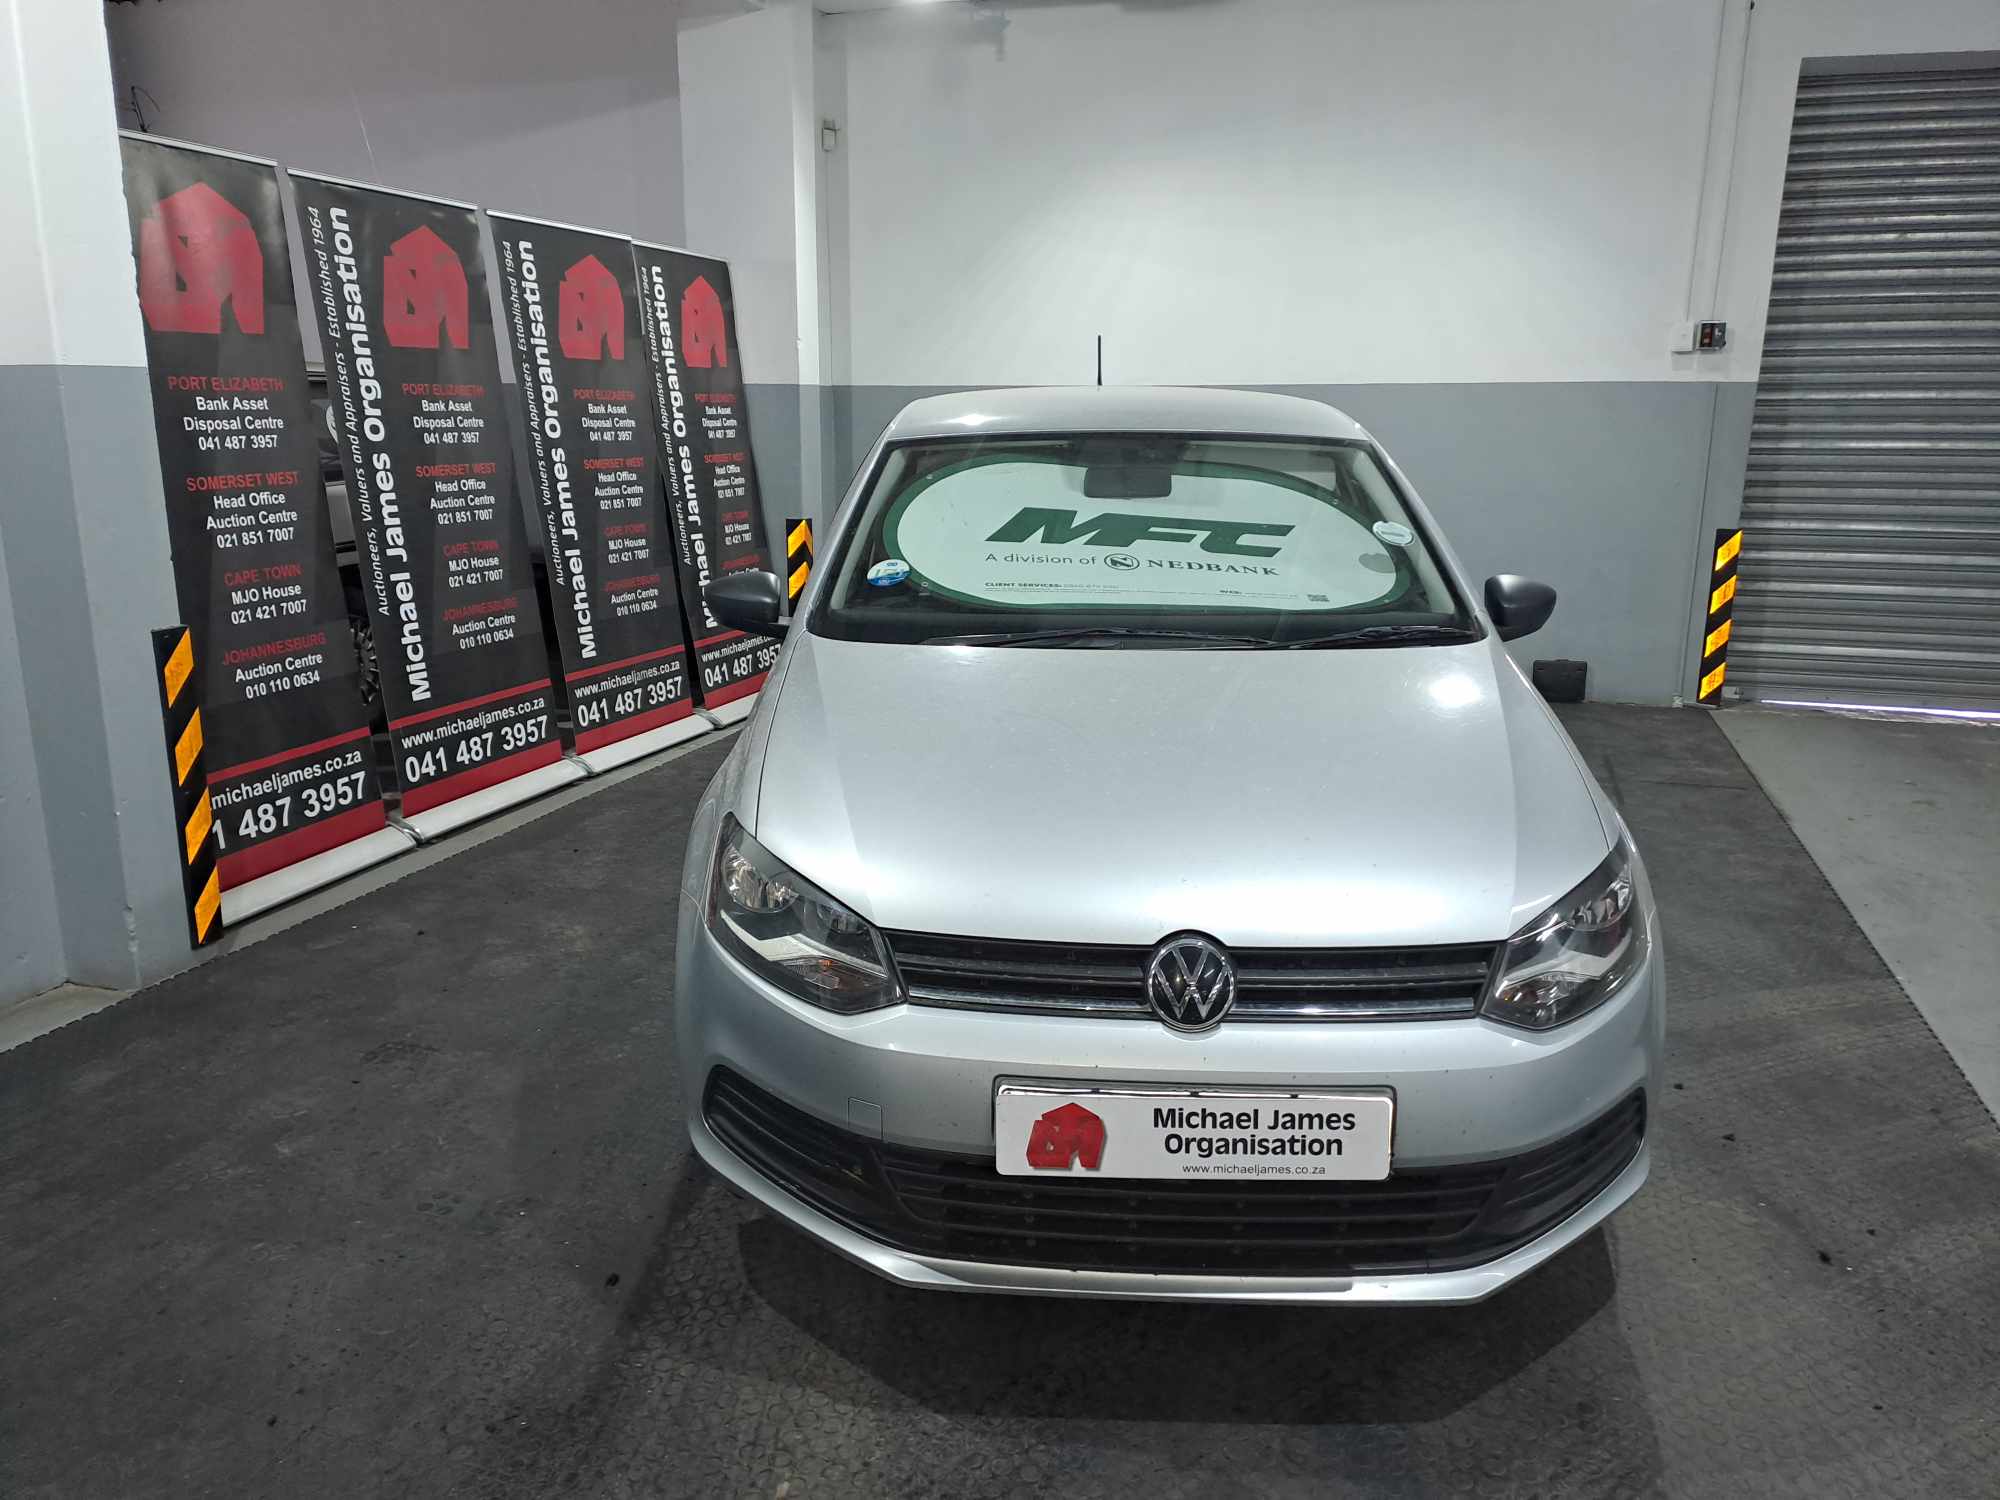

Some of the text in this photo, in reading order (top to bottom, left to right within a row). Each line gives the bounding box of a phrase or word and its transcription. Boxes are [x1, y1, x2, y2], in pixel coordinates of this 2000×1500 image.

[308, 206, 327, 245] 1964
[502, 241, 515, 274] 1964
[314, 249, 341, 338] Established
[506, 276, 527, 352] Established
[167, 376, 284, 392] PORT ELIZABETH
[334, 349, 358, 432] Appraisers
[401, 384, 430, 396] PORT
[195, 396, 269, 411] Bank Asset
[421, 400, 472, 412] Bank Asset
[521, 361, 540, 431] Appraisers
[656, 372, 670, 430] Appraisers
[588, 403, 627, 414] Bank Asset
[183, 416, 284, 433] Disposal Centre
[413, 416, 484, 430] Disposal Centre
[581, 417, 636, 429] Disposal Centre
[198, 434, 278, 451] 041 487 3957
[423, 432, 480, 444] 041 487 3957
[531, 432, 544, 457] and
[589, 431, 602, 441] 041
[651, 265, 718, 628] Mhael James Organisation
[662, 432, 673, 454] and
[329, 207, 432, 702] Michael James Organisation
[346, 435, 363, 464] and
[518, 240, 597, 659] Michael James Organisation
[416, 462, 496, 477] SOMERSET WEST
[598, 471, 637, 482] Head Office
[668, 456, 679, 496] Valuers
[186, 471, 300, 492] SOMERSET WEST
[435, 479, 486, 493] Head Office
[539, 459, 552, 506] Valuers
[594, 484, 644, 497] Auction Centre
[213, 492, 286, 510] Head Office
[352, 467, 372, 522] Valuers
[430, 494, 496, 510] Auction Centre
[600, 500, 611, 510] 021
[206, 510, 298, 530] Auction Centre
[437, 509, 493, 525] 021 851 7007
[216, 527, 294, 549] 021 851 7007
[984, 506, 1296, 558] MFC
[548, 511, 566, 586] Auctioneers,
[608, 538, 646, 550] MJO House
[448, 556, 499, 572] MJO House
[608, 554, 620, 564] 021
[621, 551, 632, 562] 421
[986, 553, 998, 562] A
[1004, 553, 1074, 566] division
[1079, 554, 1096, 566] of
[1147, 558, 1280, 576] NEDBANK
[224, 564, 304, 586] CAPE TOWN
[366, 527, 390, 616] Auctioneers,
[448, 569, 503, 588] 021 421 7007
[231, 584, 302, 606] MJO House
[611, 588, 659, 604] Auction Centre
[231, 600, 307, 625] 021 421 7007
[616, 606, 628, 616] 010
[630, 604, 640, 614] 110
[452, 614, 516, 636] Auction Centre
[223, 632, 328, 666] JOHANNESBURG
[460, 628, 514, 649] 010 110 0634
[235, 654, 323, 682] Auction Centre
[704, 667, 729, 688] 041
[732, 654, 753, 677] 487
[246, 670, 320, 699] 010 110 0634
[574, 660, 680, 699] www.michaeljames.co.za
[577, 675, 683, 728] 041 487 3957
[401, 697, 545, 749] www.michaeljames.co.za
[405, 715, 548, 783] 041 487 3957
[211, 750, 363, 810] michaeljames.co.za
[238, 796, 292, 839] 487
[301, 770, 366, 818] 3957
[1152, 1106, 1356, 1131] Michael James
[1164, 1133, 1343, 1160] Organisation
[1182, 1162, 1326, 1177] www.michaeljames.co.za
